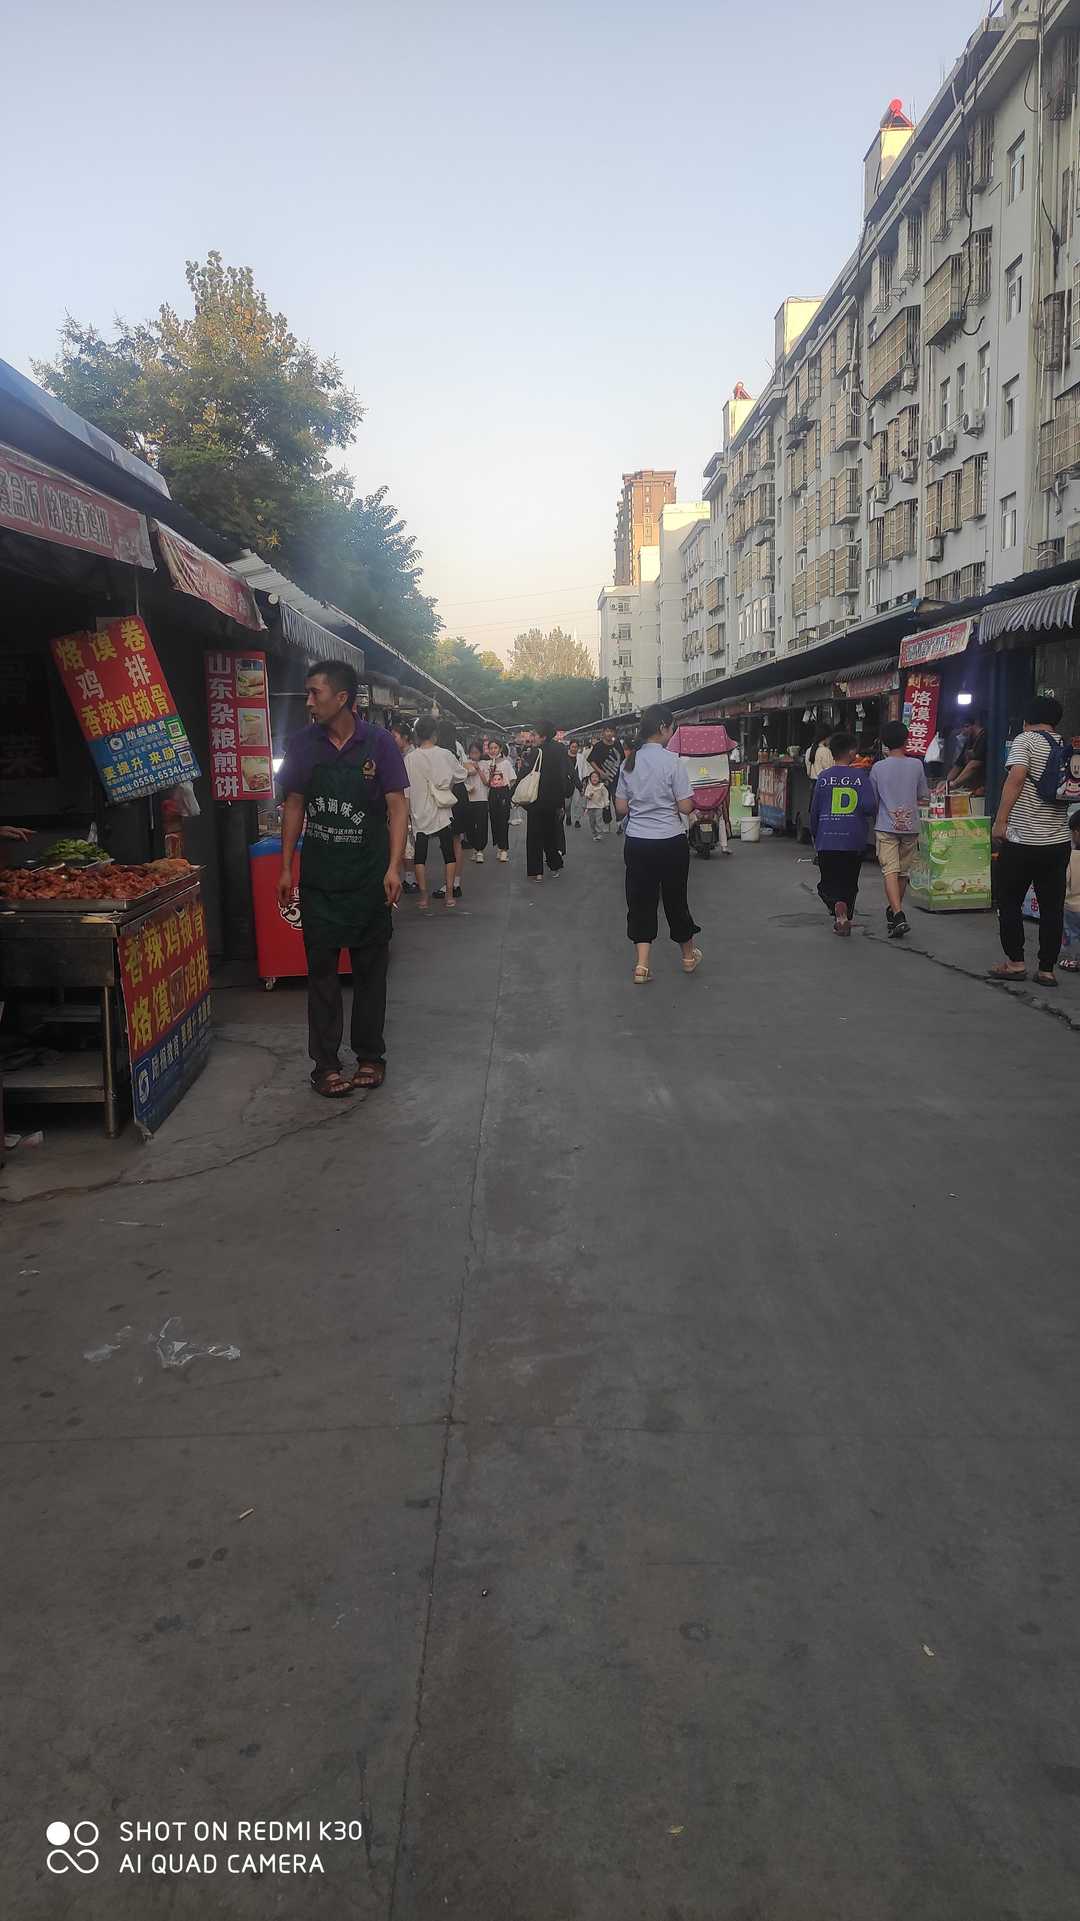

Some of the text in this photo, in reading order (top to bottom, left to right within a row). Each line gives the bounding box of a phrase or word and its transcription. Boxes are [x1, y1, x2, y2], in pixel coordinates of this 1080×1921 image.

[80, 683, 170, 737] 香辣鸡锁骨
[208, 653, 239, 799] 山东杂粮煎饼
[905, 690, 932, 753] 烙馍卷菜
[831, 787, 858, 814] D
